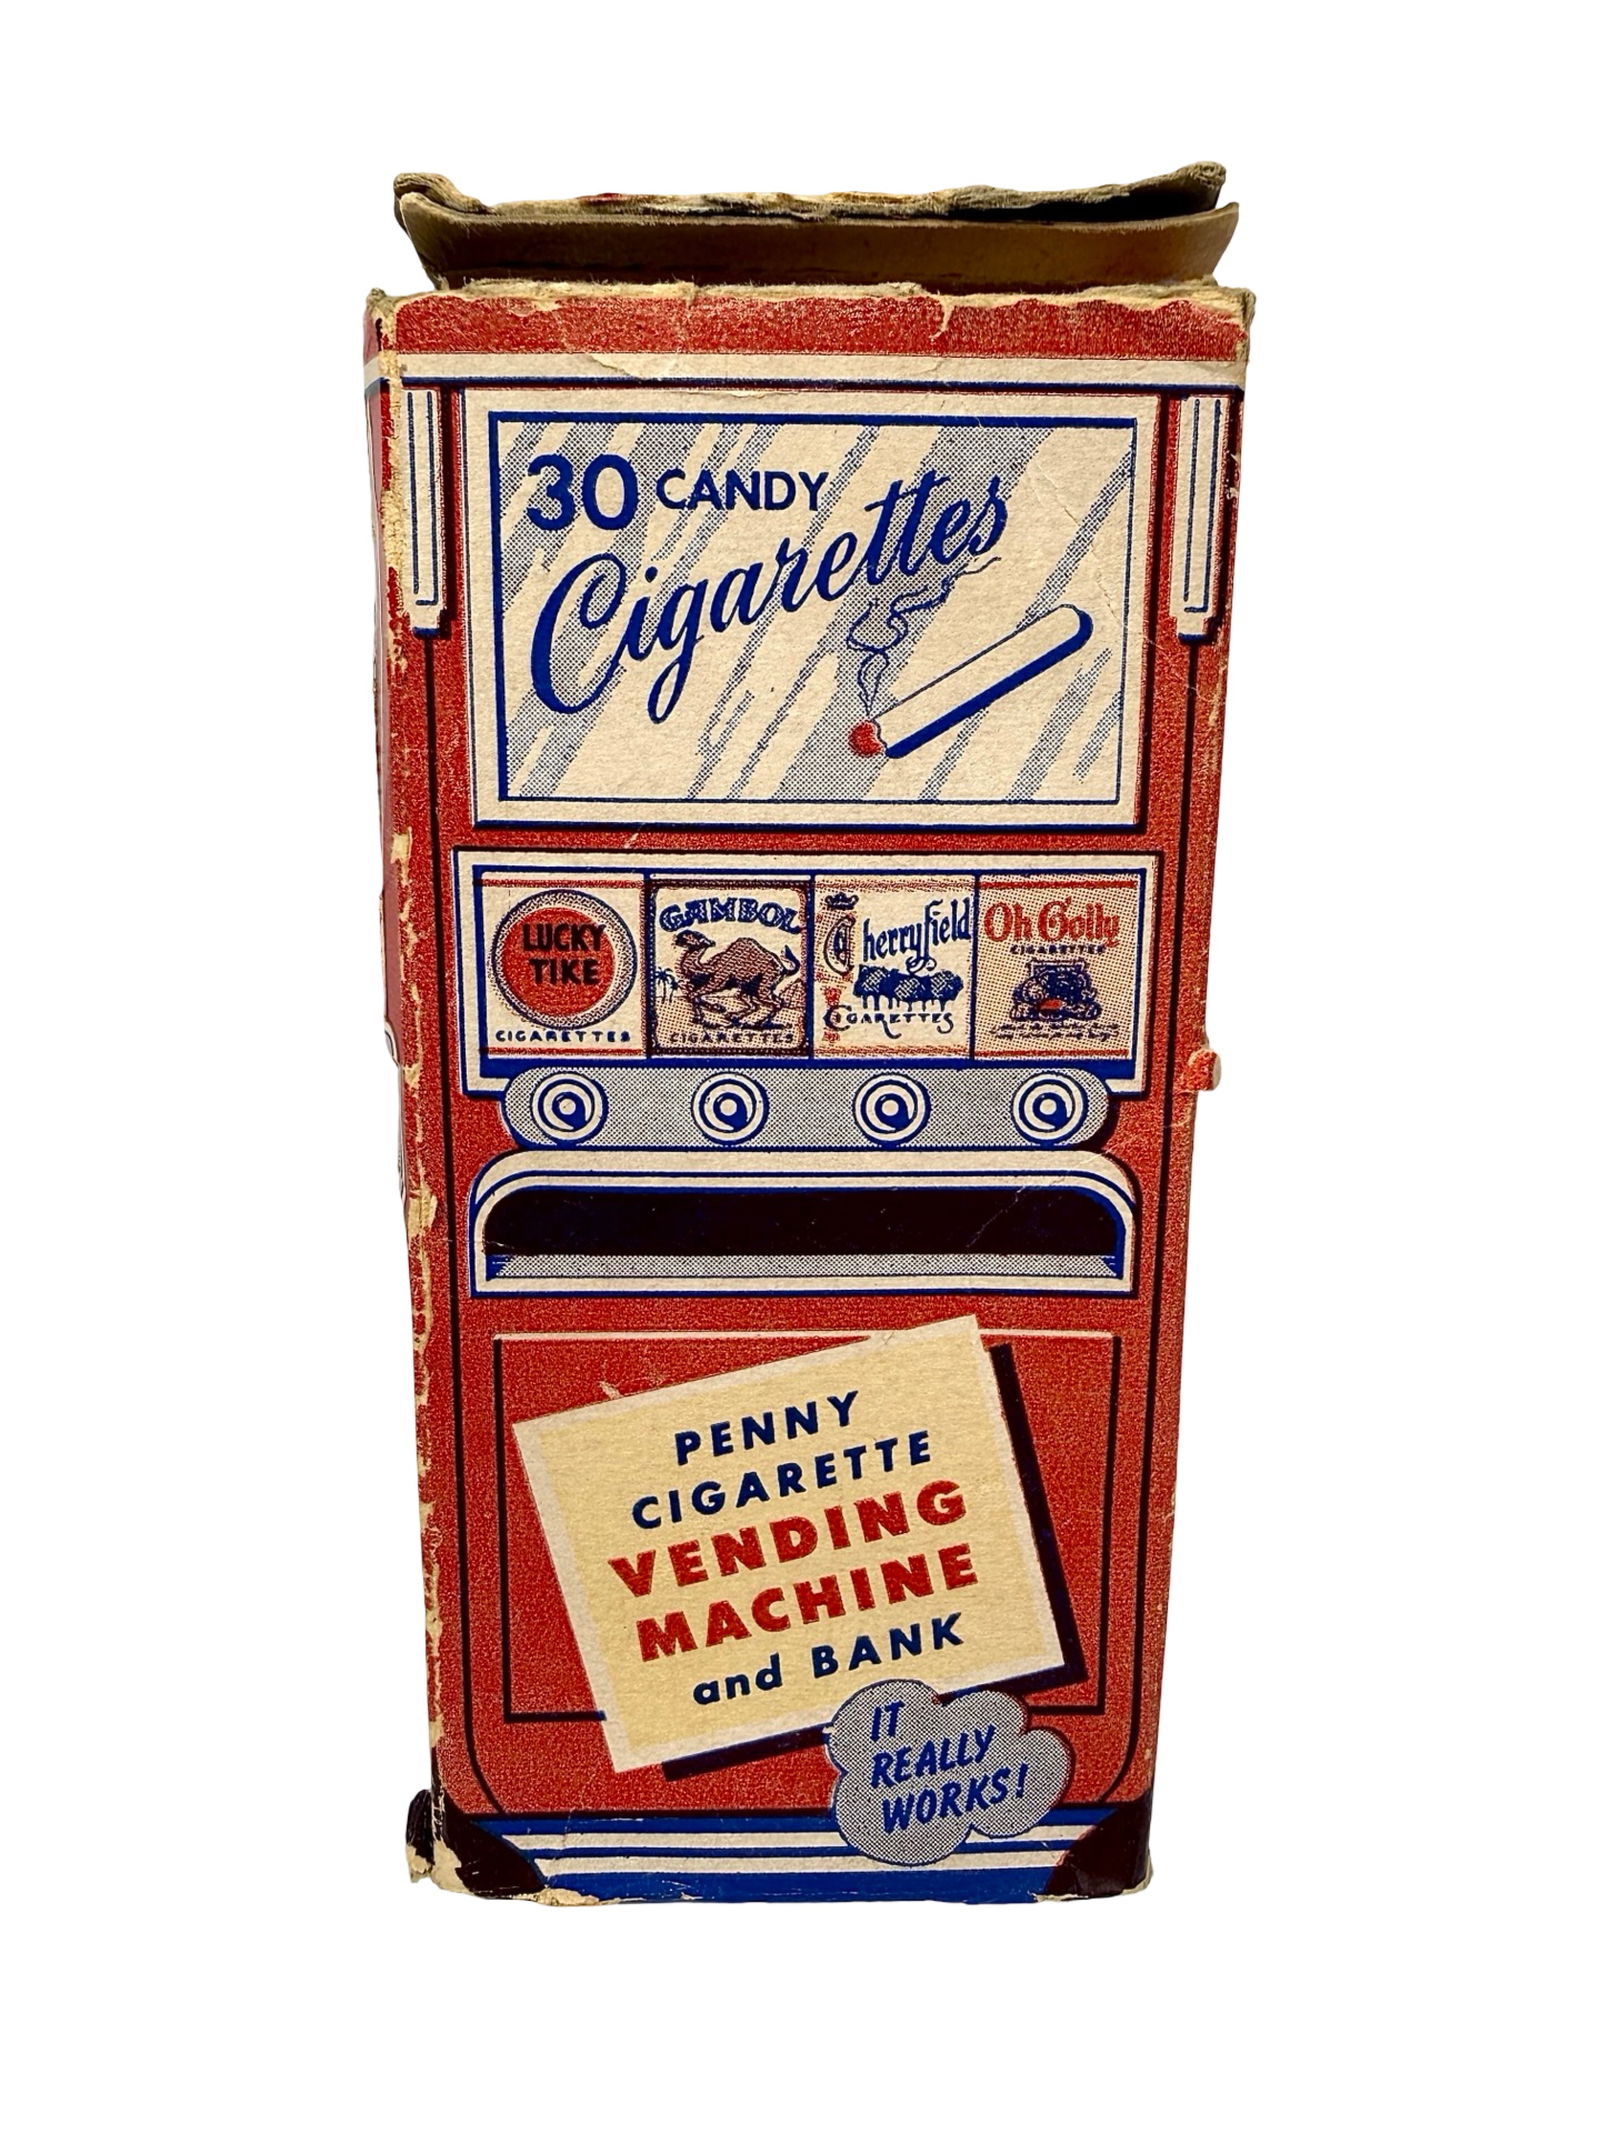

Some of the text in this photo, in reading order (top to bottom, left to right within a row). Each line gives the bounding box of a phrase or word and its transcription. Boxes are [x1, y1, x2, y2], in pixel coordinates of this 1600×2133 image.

[527, 453, 829, 532] 30 CANDY
[531, 470, 1008, 725] Cigarettes
[521, 923, 608, 951] LUCKY
[659, 897, 801, 934] GAMBOL
[984, 897, 1121, 947] Oh Golly
[529, 958, 600, 985] TIKE
[495, 1030, 631, 1042] CIGARETTES
[675, 1390, 859, 1466] PENNY
[631, 1430, 932, 1530] CIGARETTE
[608, 1479, 967, 1598] VENDING
[635, 1542, 979, 1663] MACHINE
[692, 1611, 965, 1706] and BANK
[870, 1725, 996, 1789] REALLY
[871, 1701, 905, 1741] IT
[881, 1762, 1030, 1834] WORKS!
